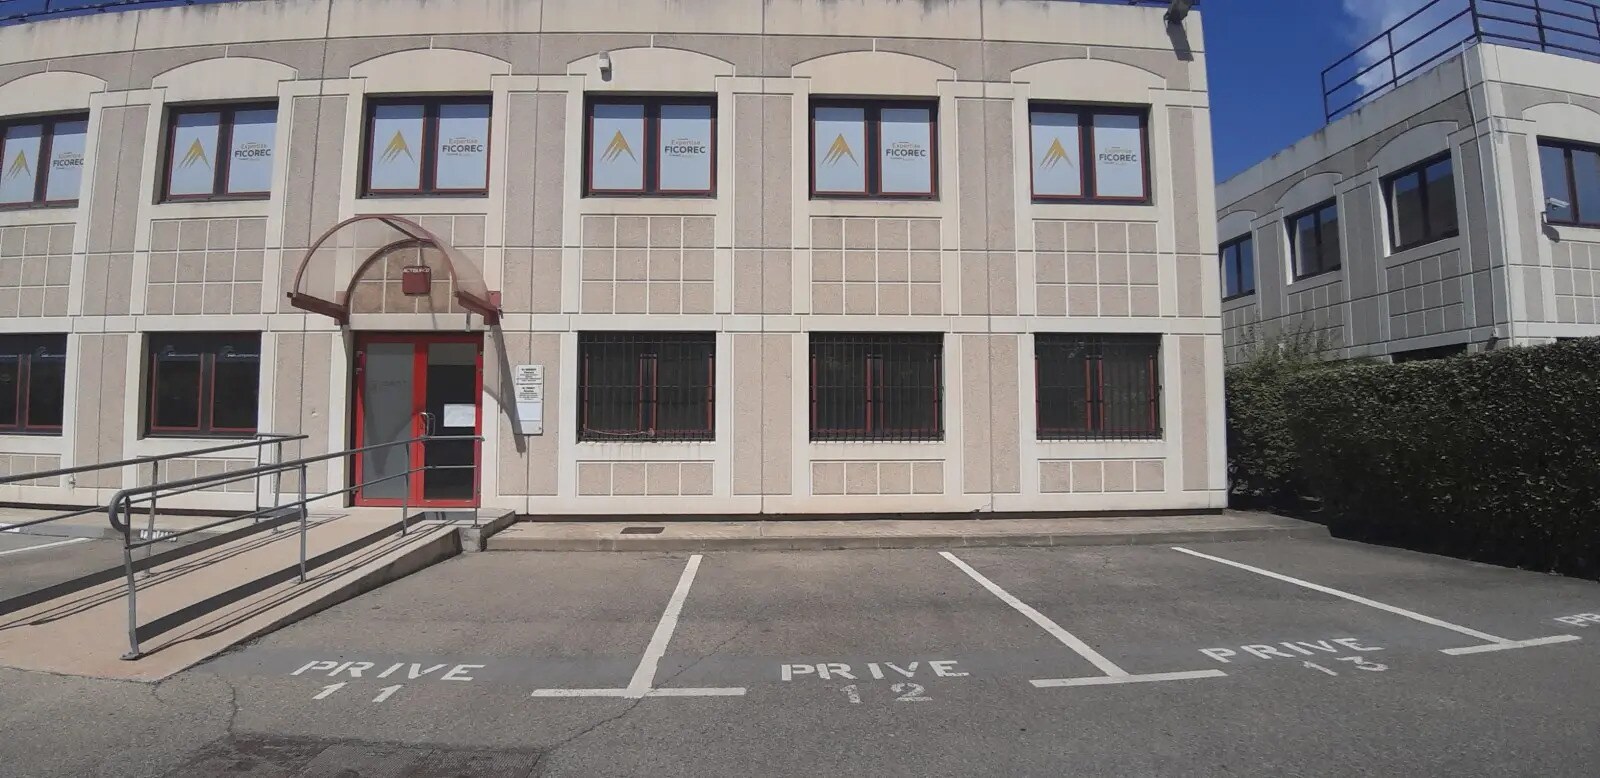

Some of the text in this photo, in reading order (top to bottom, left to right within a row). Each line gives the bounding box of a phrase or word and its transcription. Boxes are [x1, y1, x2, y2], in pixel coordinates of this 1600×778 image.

[234, 148, 271, 157] FICOREC
[442, 144, 484, 153] FICOREC
[665, 145, 706, 153] FICOREC
[885, 148, 926, 157] FICOREC
[53, 158, 84, 167] FICOREC
[1098, 153, 1137, 162] FICOREC
[1198, 637, 1385, 663] PRIVE
[290, 660, 486, 681] PRIVE
[781, 660, 969, 681] PRIVE
[1303, 655, 1388, 677] 13
[312, 681, 403, 702] 11
[840, 682, 933, 703] 12
